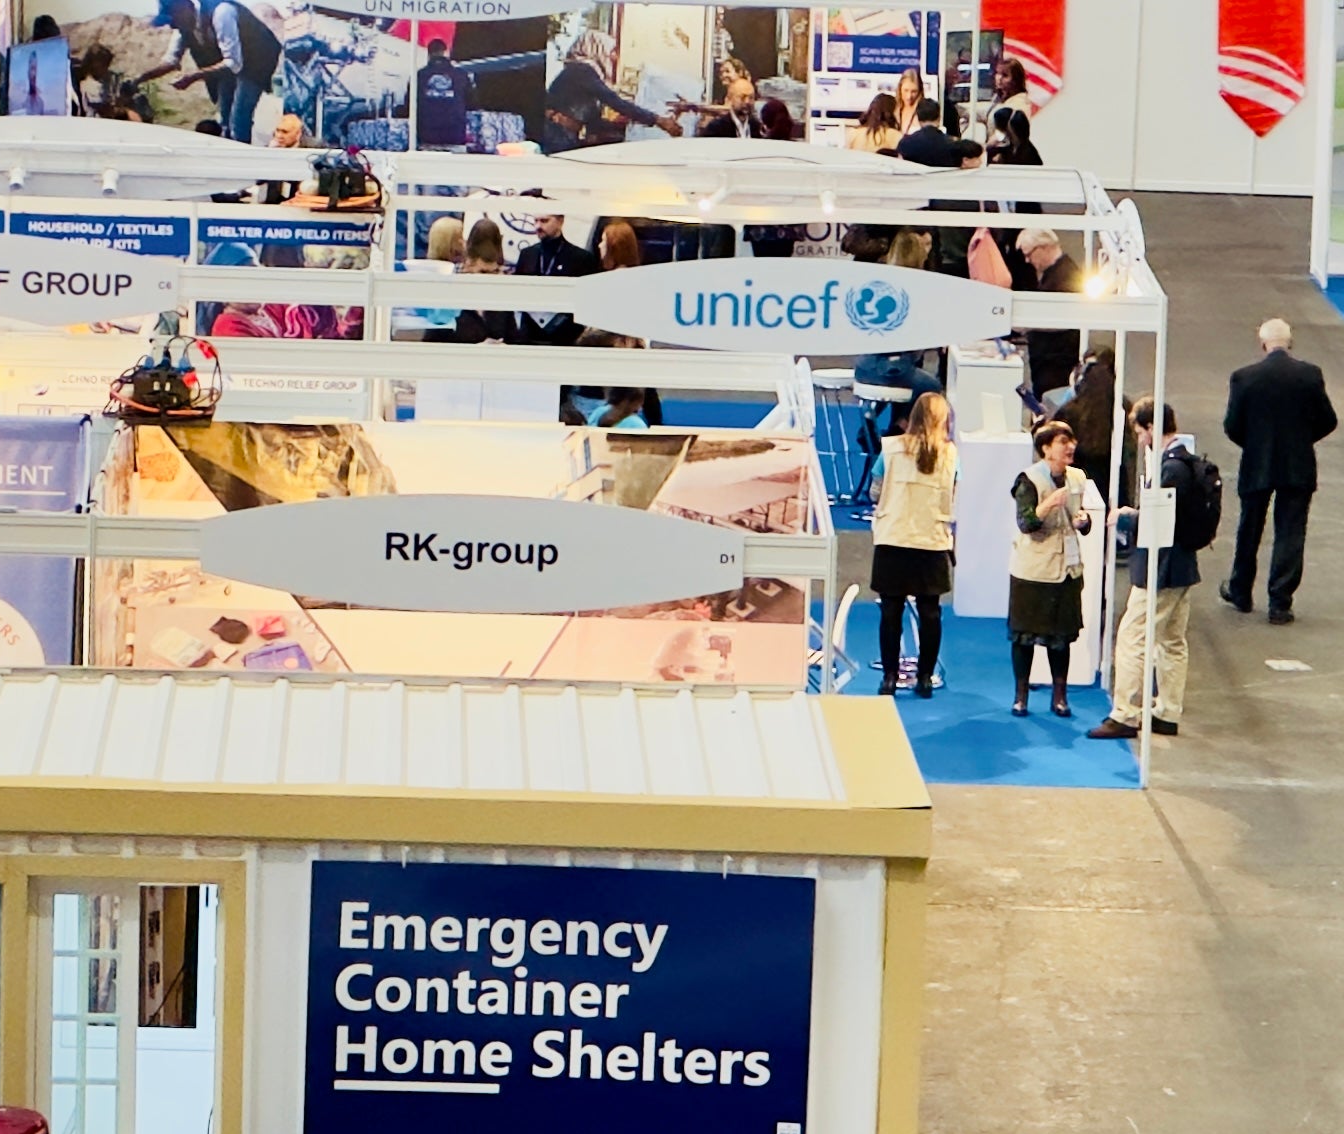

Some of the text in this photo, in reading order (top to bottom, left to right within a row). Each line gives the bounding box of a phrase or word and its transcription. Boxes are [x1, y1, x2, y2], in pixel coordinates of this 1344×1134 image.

[401, 1, 511, 15] MIGRATION
[28, 220, 104, 235] HOUSEHOLD
[116, 222, 174, 237] TEXTILES
[207, 225, 370, 242] SHELTER AND FIELD ITEMS
[113, 237, 141, 251] KITS
[22, 271, 133, 297] GROUP
[157, 280, 173, 290] C6
[674, 279, 839, 330] unicef
[385, 532, 559, 572] RK-group
[719, 553, 736, 564] D1
[338, 901, 668, 973] Emergency
[333, 963, 629, 1019] Container
[333, 1025, 772, 1088] Home Shelters
